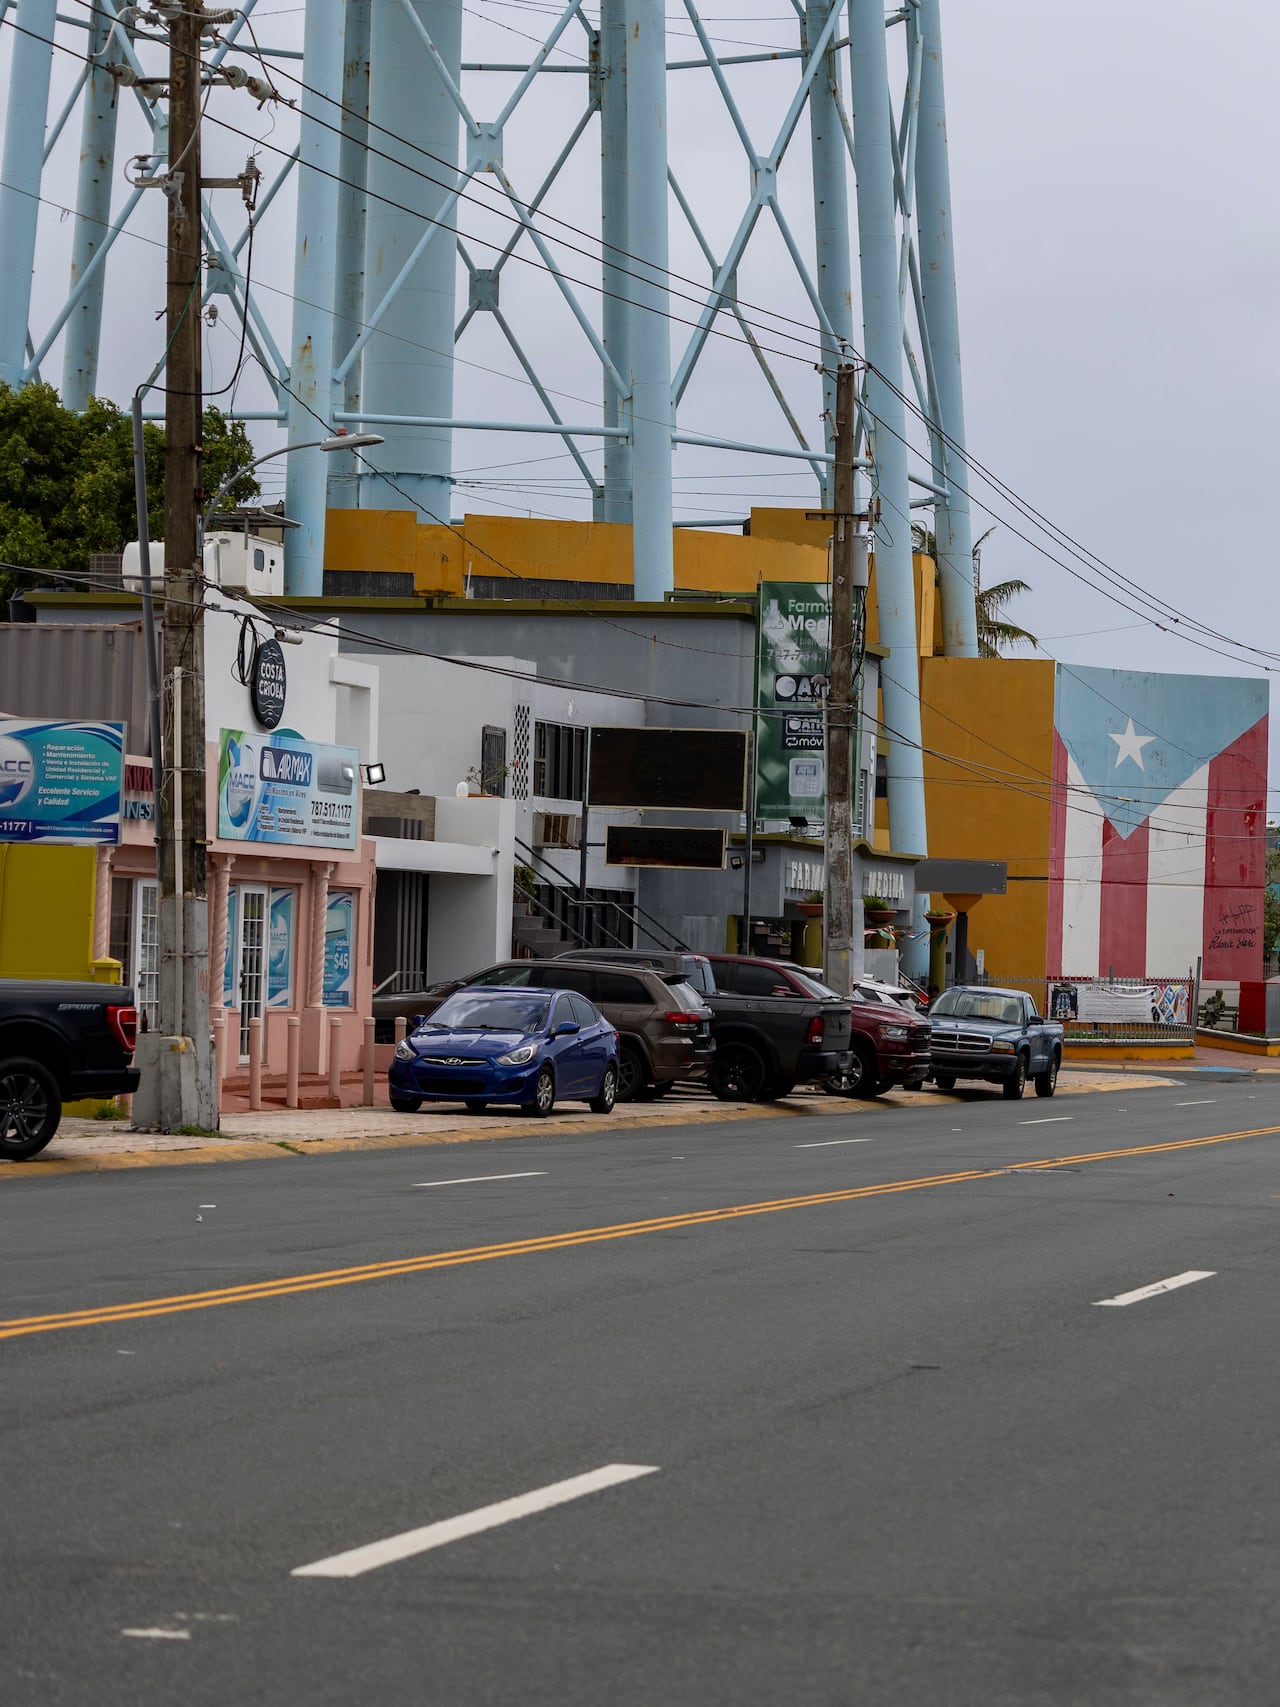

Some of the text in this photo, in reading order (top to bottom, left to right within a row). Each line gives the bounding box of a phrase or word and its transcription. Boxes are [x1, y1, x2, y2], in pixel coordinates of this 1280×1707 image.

[260, 662, 284, 682] COSTA
[46, 744, 85, 752] Reparación
[46, 751, 96, 760] Mantenimiento
[277, 753, 311, 783] AIRMAX
[797, 766, 816, 775] ATM
[45, 773, 74, 781] Comercial
[229, 772, 255, 789] MACC
[38, 786, 100, 797] Excelente Servicio
[37, 797, 69, 806] y Calidad
[311, 801, 352, 818] 787.517.1177
[868, 871, 905, 899] MEDINA
[334, 952, 349, 970] $45
